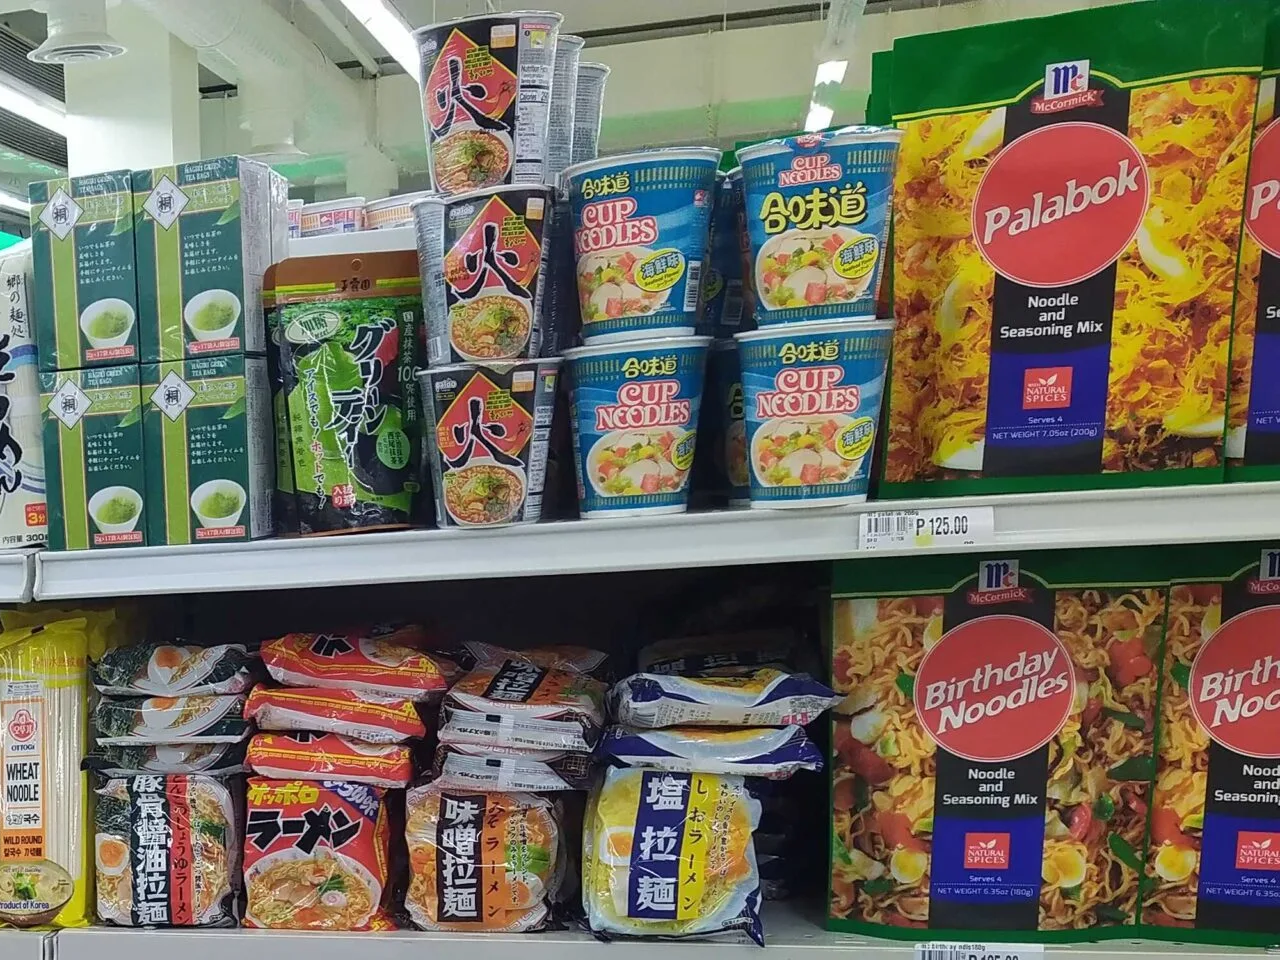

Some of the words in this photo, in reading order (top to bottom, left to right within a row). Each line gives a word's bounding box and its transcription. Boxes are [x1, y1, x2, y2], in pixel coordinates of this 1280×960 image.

[431, 57, 512, 137] 火
[1033, 91, 1098, 113] McCormick
[790, 153, 831, 172] CUP
[778, 164, 842, 186] NOODLES
[582, 198, 637, 226] CUP
[983, 159, 1142, 246] Palabok
[574, 220, 658, 254] NOODLES
[451, 224, 532, 300] 火
[1028, 293, 1079, 308] Noodle
[1039, 308, 1066, 322] and
[999, 322, 1073, 340] Seasoning
[1076, 320, 1103, 334] Mix
[773, 365, 846, 392] CUP
[619, 379, 681, 405] CUP
[1026, 394, 1068, 404] SPICES
[1027, 385, 1067, 396] NATURAL
[756, 385, 860, 419] NOODLES
[596, 399, 691, 430] NOODLES
[1028, 416, 1054, 424] Serves
[1056, 416, 1063, 424] 4
[446, 399, 525, 468] 火
[992, 431, 1008, 439] NET
[1009, 431, 1039, 439] WEIGHT
[1070, 427, 1098, 438] (200g)
[970, 588, 1026, 604] McCormick
[925, 646, 1059, 711] Birthday
[937, 671, 1069, 736] Noodles
[5, 761, 39, 781] WHEAT
[968, 767, 1016, 781] Noodle
[6, 784, 39, 801] NOODLE
[979, 781, 1003, 793] and
[943, 793, 1010, 807] Seasoning
[1013, 793, 1038, 805] Mix
[246, 803, 365, 855] ラーメン
[3, 836, 22, 844] WILD
[24, 836, 43, 844] ROUND
[967, 855, 1006, 864] SPICES
[968, 848, 1005, 857] NATURAL
[969, 875, 994, 883] Serves
[937, 887, 952, 895] NET
[23, 901, 30, 909] of
[31, 901, 49, 910] Korea
